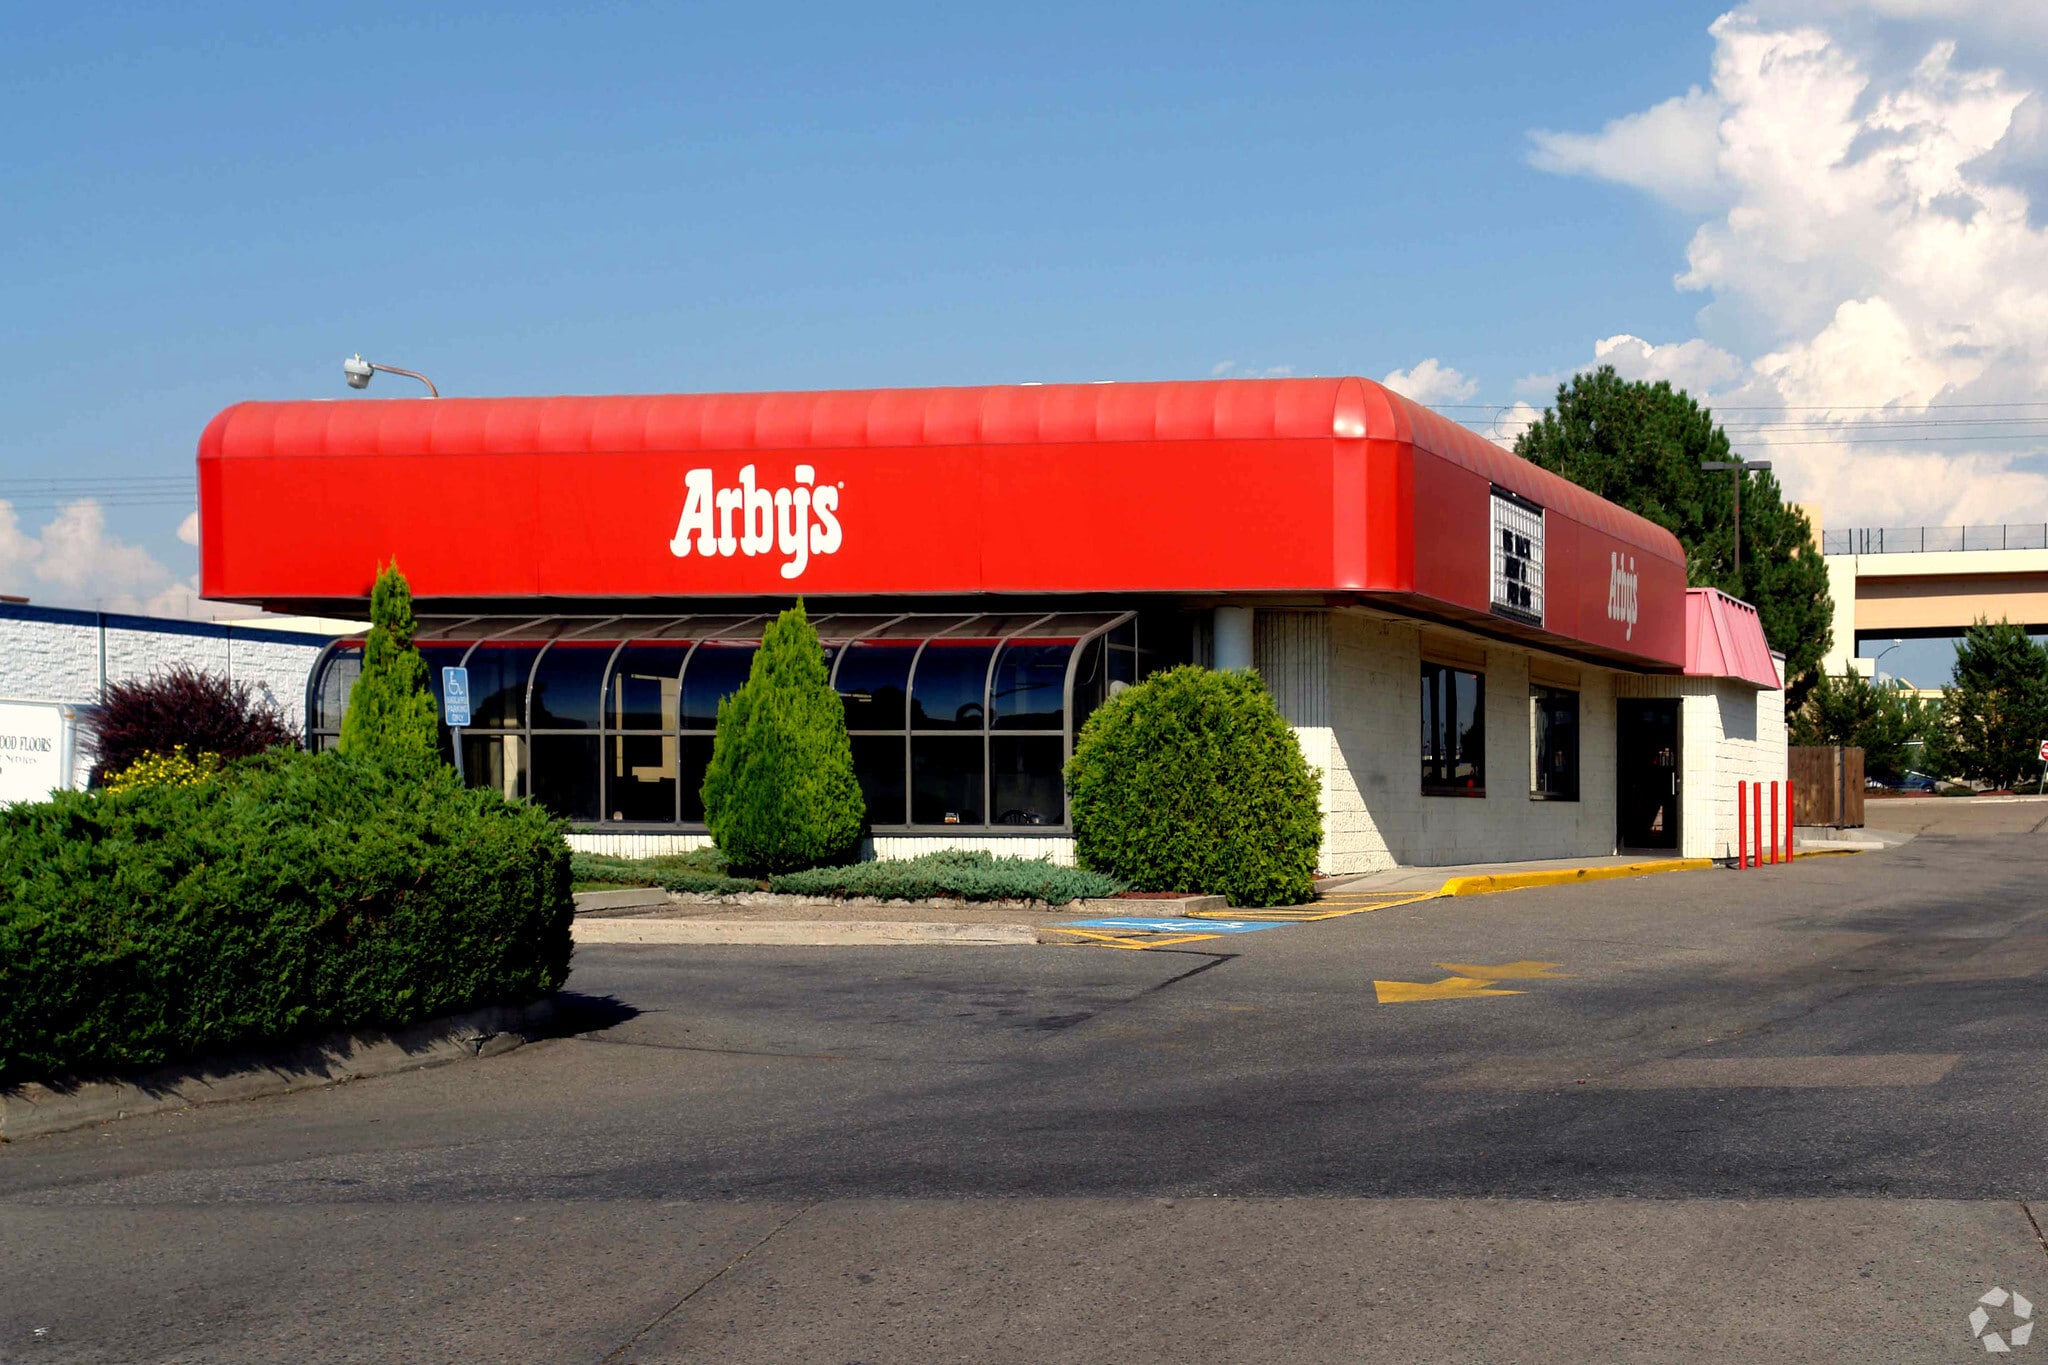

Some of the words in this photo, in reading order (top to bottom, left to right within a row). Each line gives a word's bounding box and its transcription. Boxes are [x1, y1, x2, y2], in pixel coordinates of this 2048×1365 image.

[669, 463, 844, 579] Arby's
[1607, 551, 1638, 641] Arby's
[19, 736, 51, 752] FLOORS
